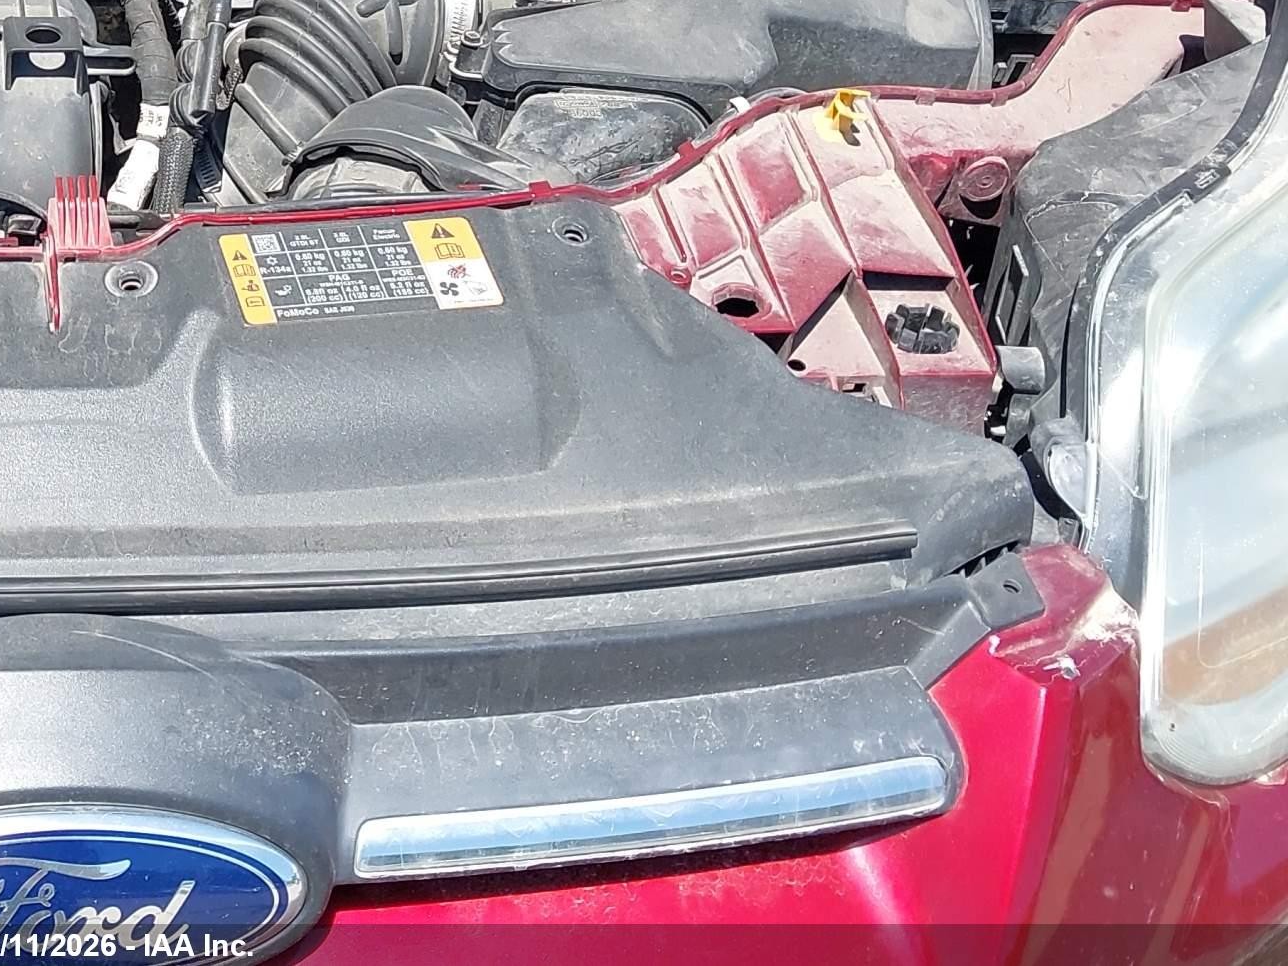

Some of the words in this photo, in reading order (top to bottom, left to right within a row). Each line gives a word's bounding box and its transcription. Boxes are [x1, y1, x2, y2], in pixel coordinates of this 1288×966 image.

[353, 249, 365, 257] kg
[396, 246, 408, 254] kg
[314, 252, 326, 260] kg
[260, 266, 292, 274] R-134a
[392, 268, 414, 277] POE
[328, 274, 351, 282] PAG
[370, 290, 384, 299] cc)
[414, 287, 429, 296] cc)
[307, 295, 327, 303] (200
[328, 293, 343, 302] cc)
[277, 308, 319, 318] FoMoCo
